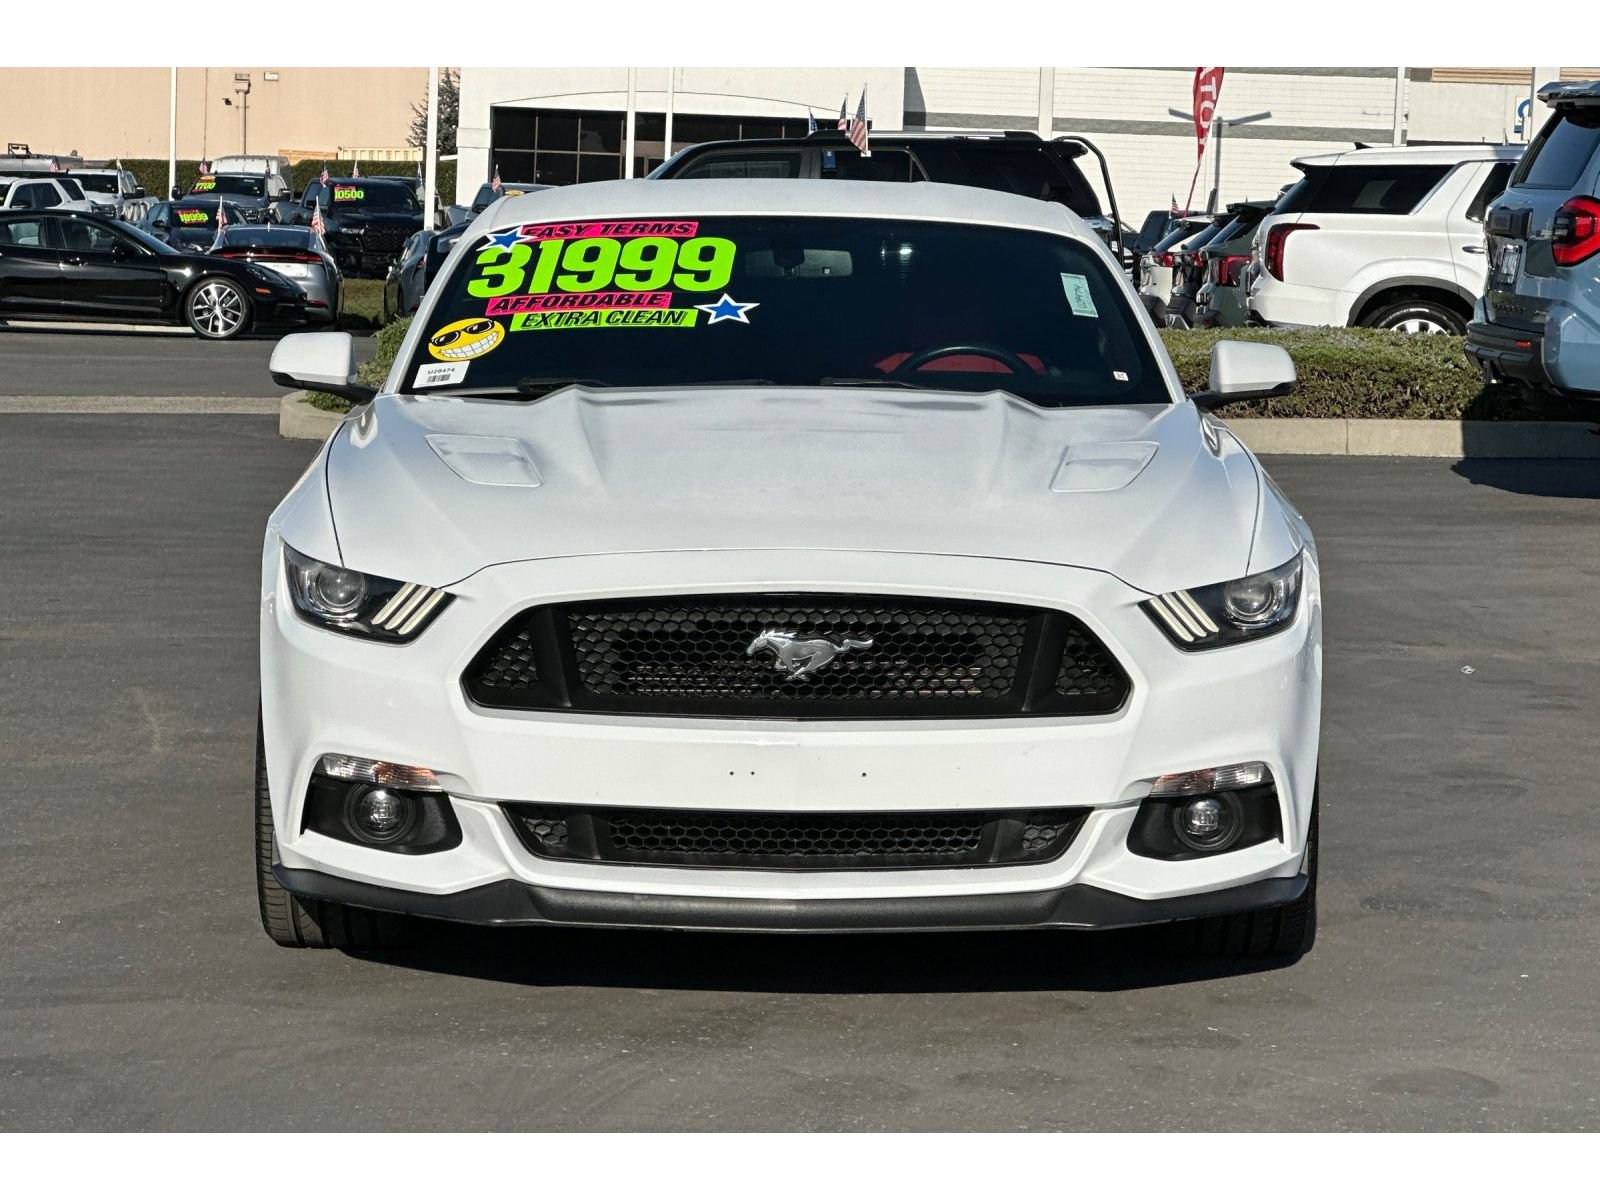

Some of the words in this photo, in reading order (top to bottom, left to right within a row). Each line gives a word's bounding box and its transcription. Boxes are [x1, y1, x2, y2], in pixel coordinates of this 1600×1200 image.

[335, 190, 364, 199] 10500
[523, 224, 591, 237] EASY
[600, 222, 693, 235] TERMS
[467, 236, 737, 298] 31999
[491, 293, 666, 311] AFFORDABLE
[521, 310, 600, 328] EXTRA
[605, 310, 688, 326] CLEAN
